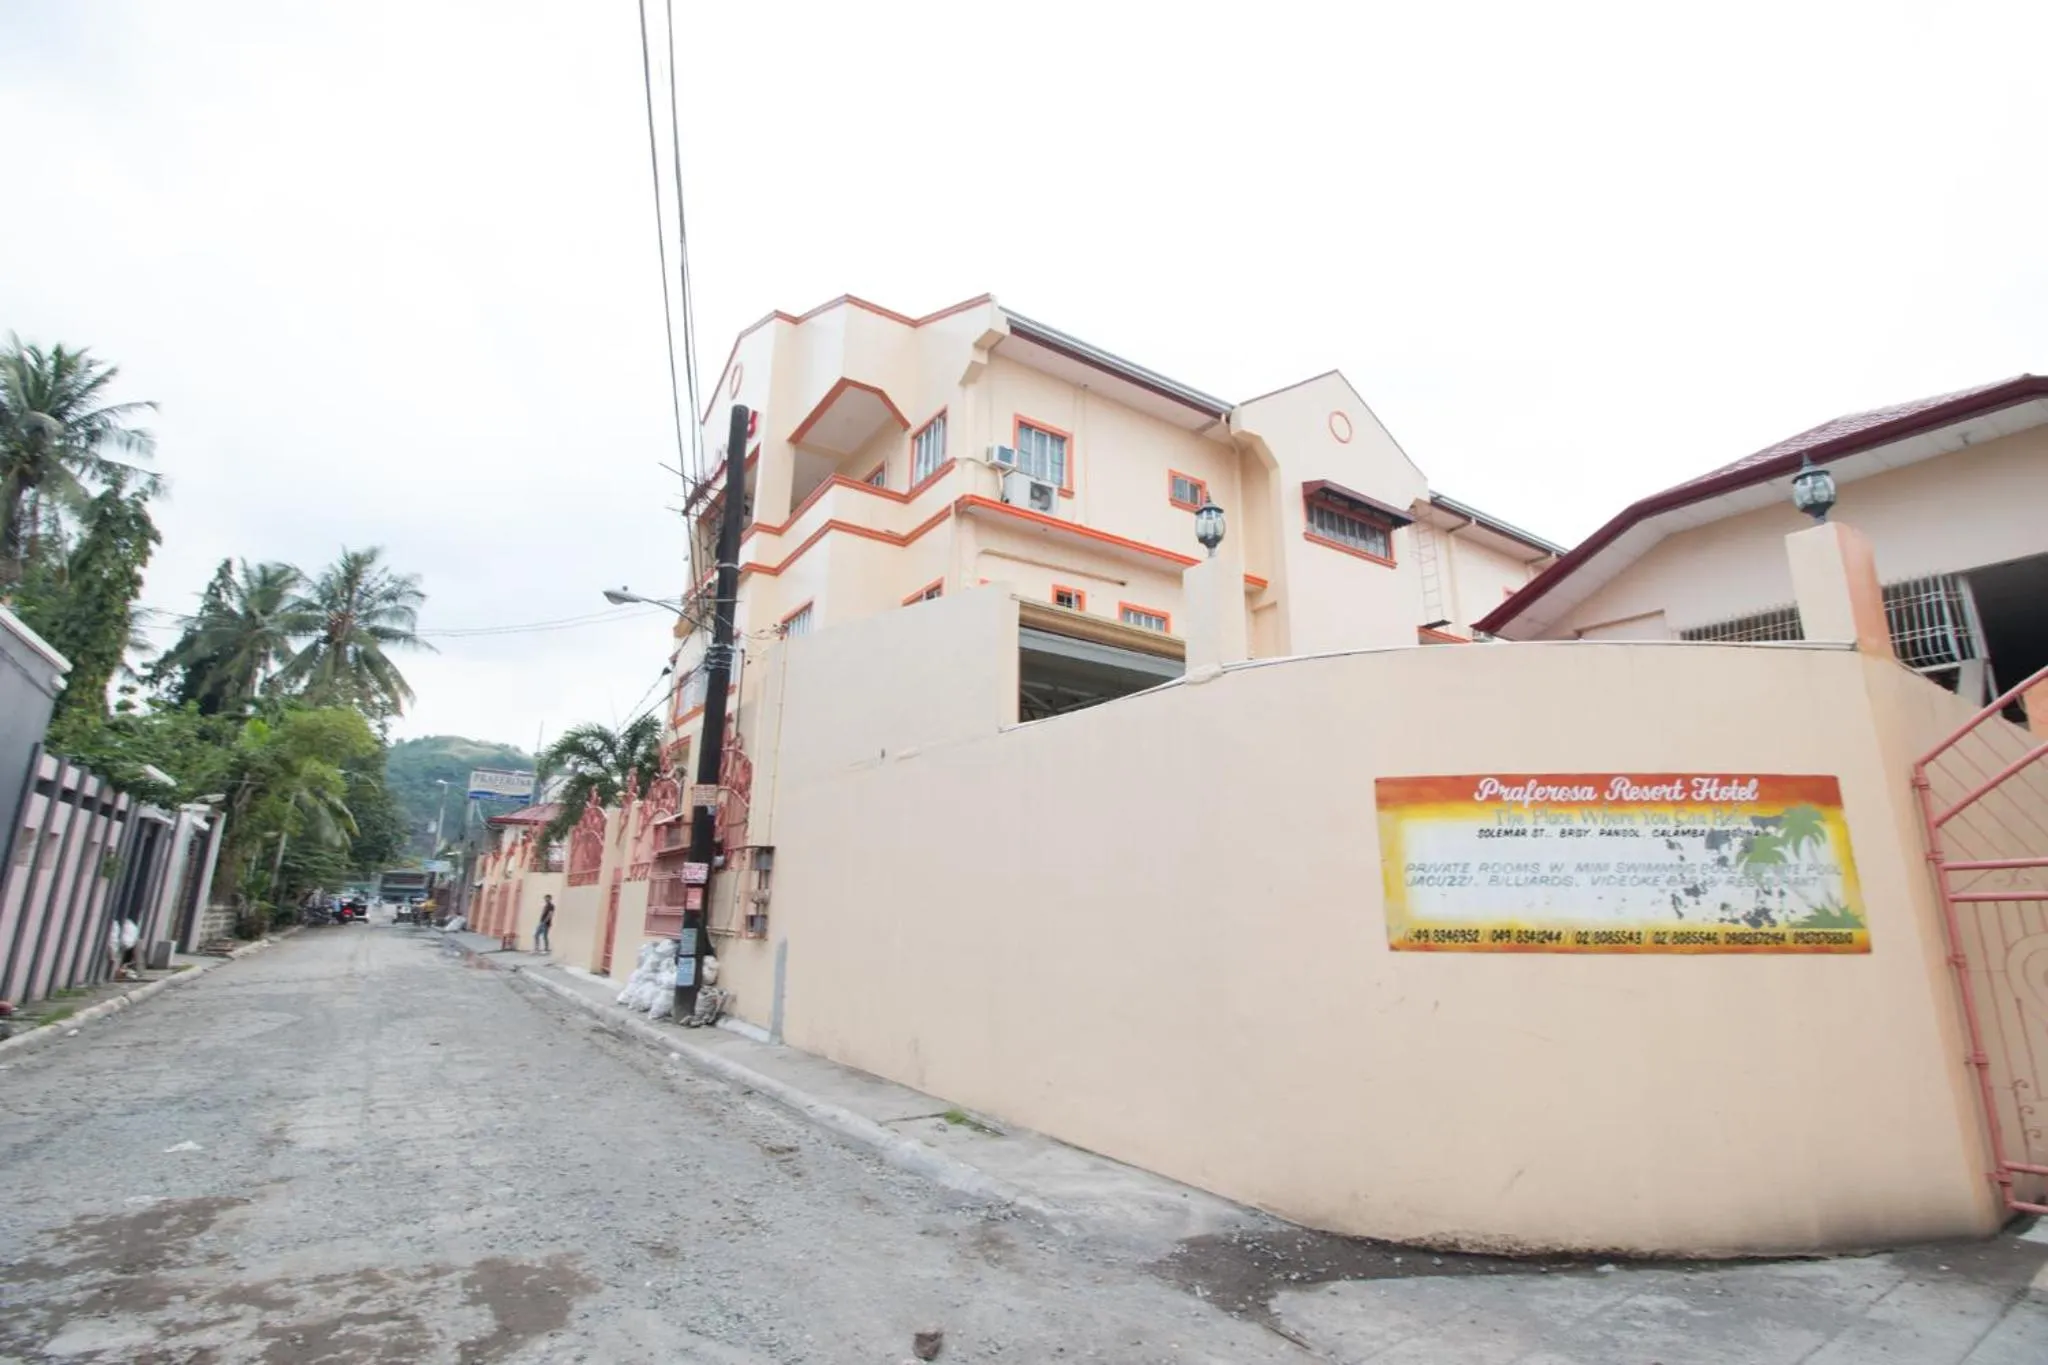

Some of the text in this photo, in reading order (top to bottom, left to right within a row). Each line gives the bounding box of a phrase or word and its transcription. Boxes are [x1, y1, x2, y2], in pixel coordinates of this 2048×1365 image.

[1474, 776, 1759, 808] Praferosa Resort Hotel
[1404, 862, 1471, 874] PRIVATE
[1478, 862, 1541, 874] ROOMS
[1590, 874, 1660, 887] VIDEOKE
